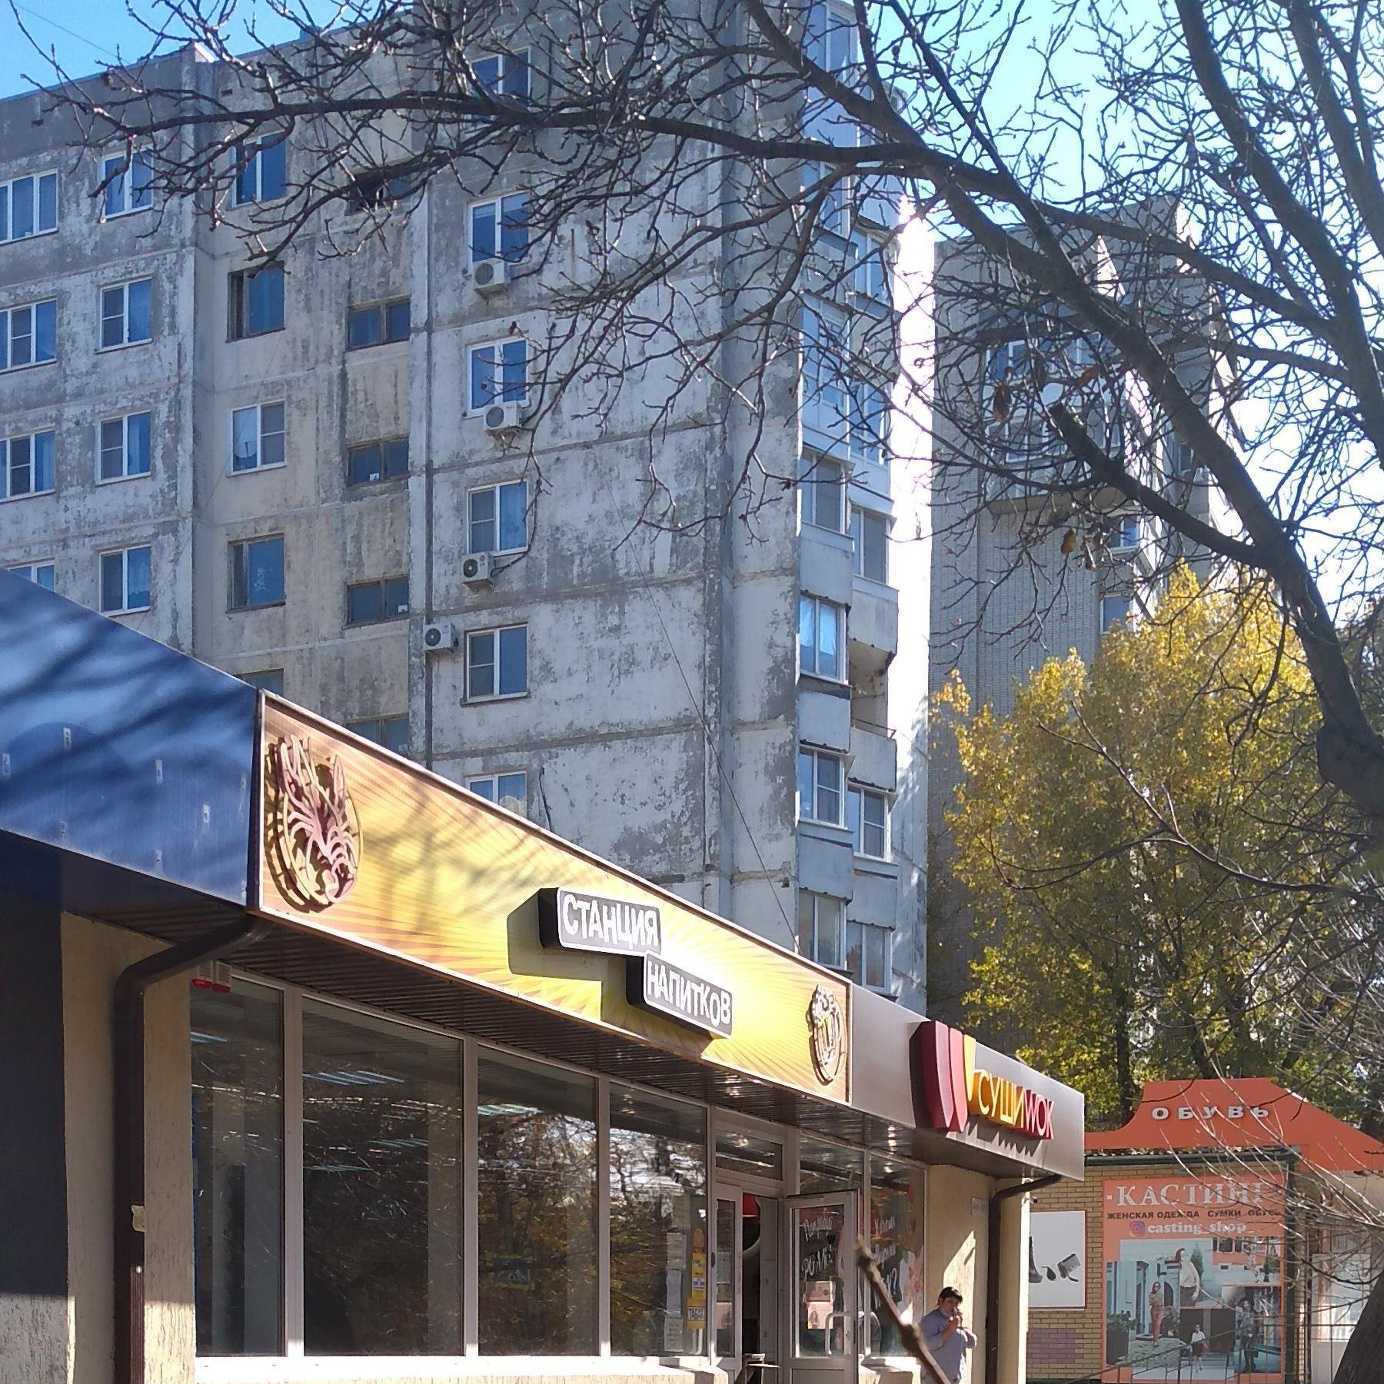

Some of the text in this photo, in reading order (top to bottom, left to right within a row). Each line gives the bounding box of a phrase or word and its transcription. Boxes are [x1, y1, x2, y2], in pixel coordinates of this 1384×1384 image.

[563, 893, 658, 947] СТАНЦИЯ
[647, 960, 732, 1028] НАПИТКОВ
[1151, 1105, 1269, 1120] ОБУВЬ
[1107, 1210, 1155, 1220] ЖЕНСКАЯ
[1207, 1209, 1242, 1218] СУМКИ
